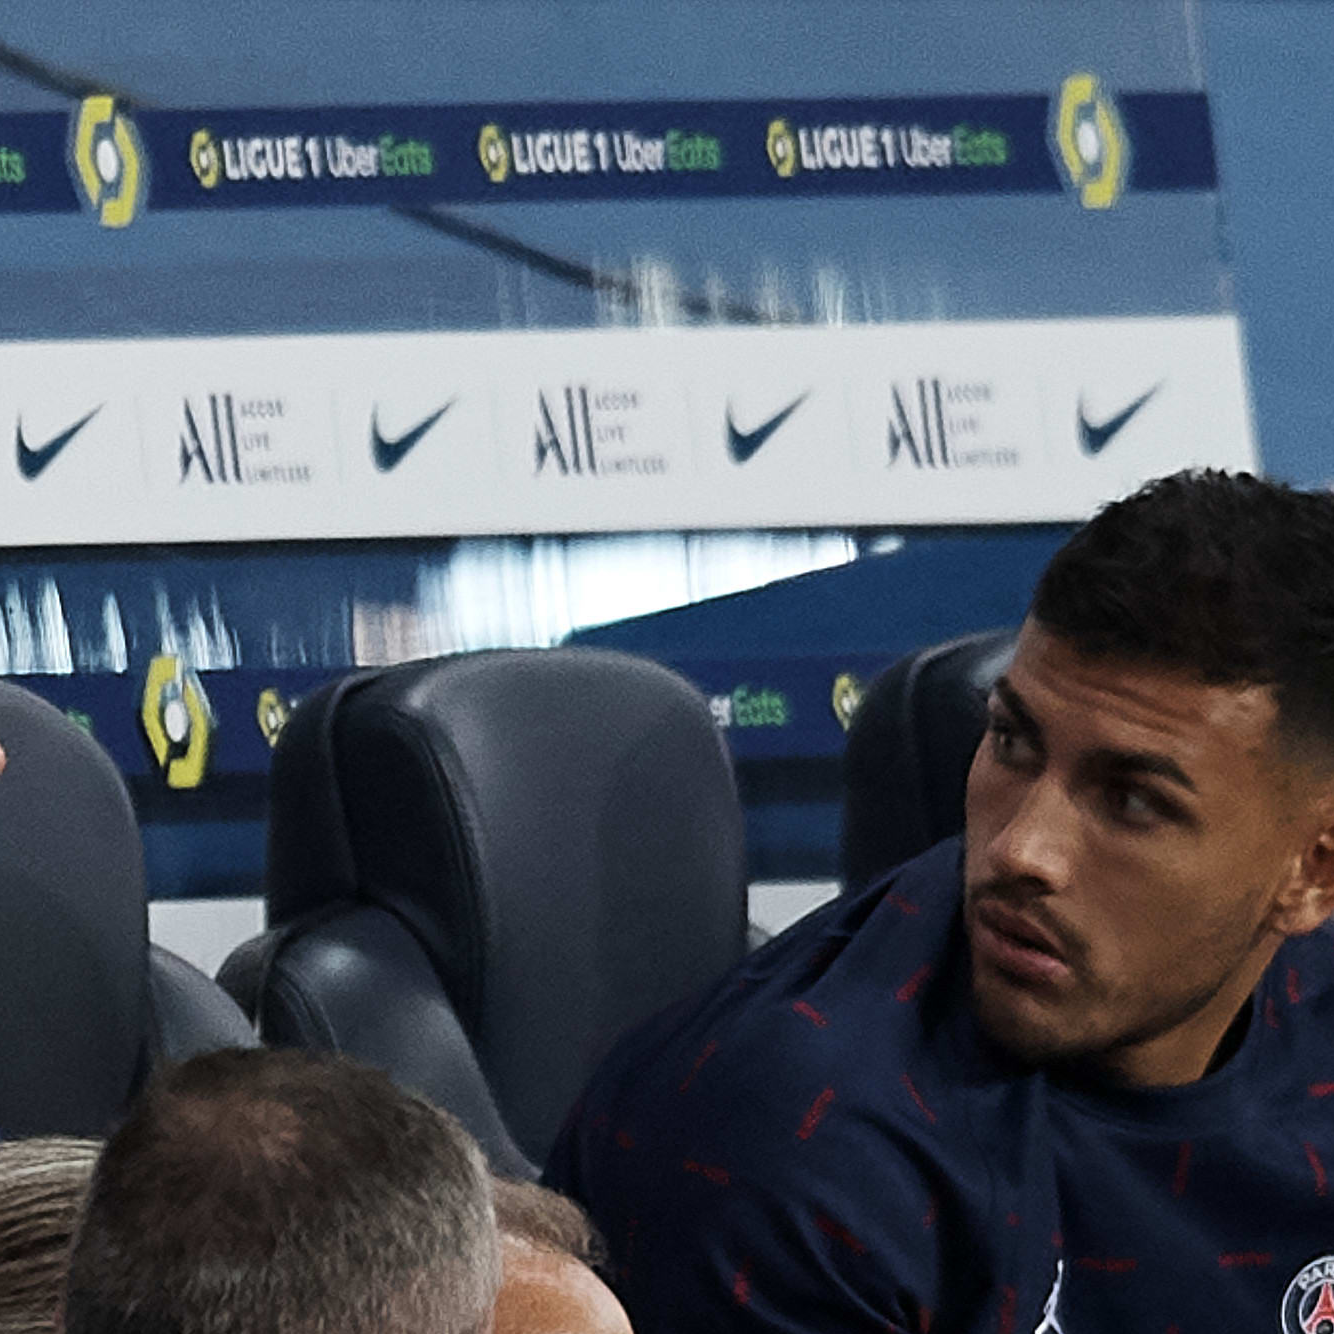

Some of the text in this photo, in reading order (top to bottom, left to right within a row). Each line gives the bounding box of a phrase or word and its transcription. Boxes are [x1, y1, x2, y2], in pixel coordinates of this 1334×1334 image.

[222, 135, 304, 181] LIGUE
[305, 136, 321, 179] 1
[511, 130, 593, 174] LIGUE
[593, 131, 609, 172] 1
[798, 125, 879, 170] LIGUE
[880, 125, 896, 168] 1
